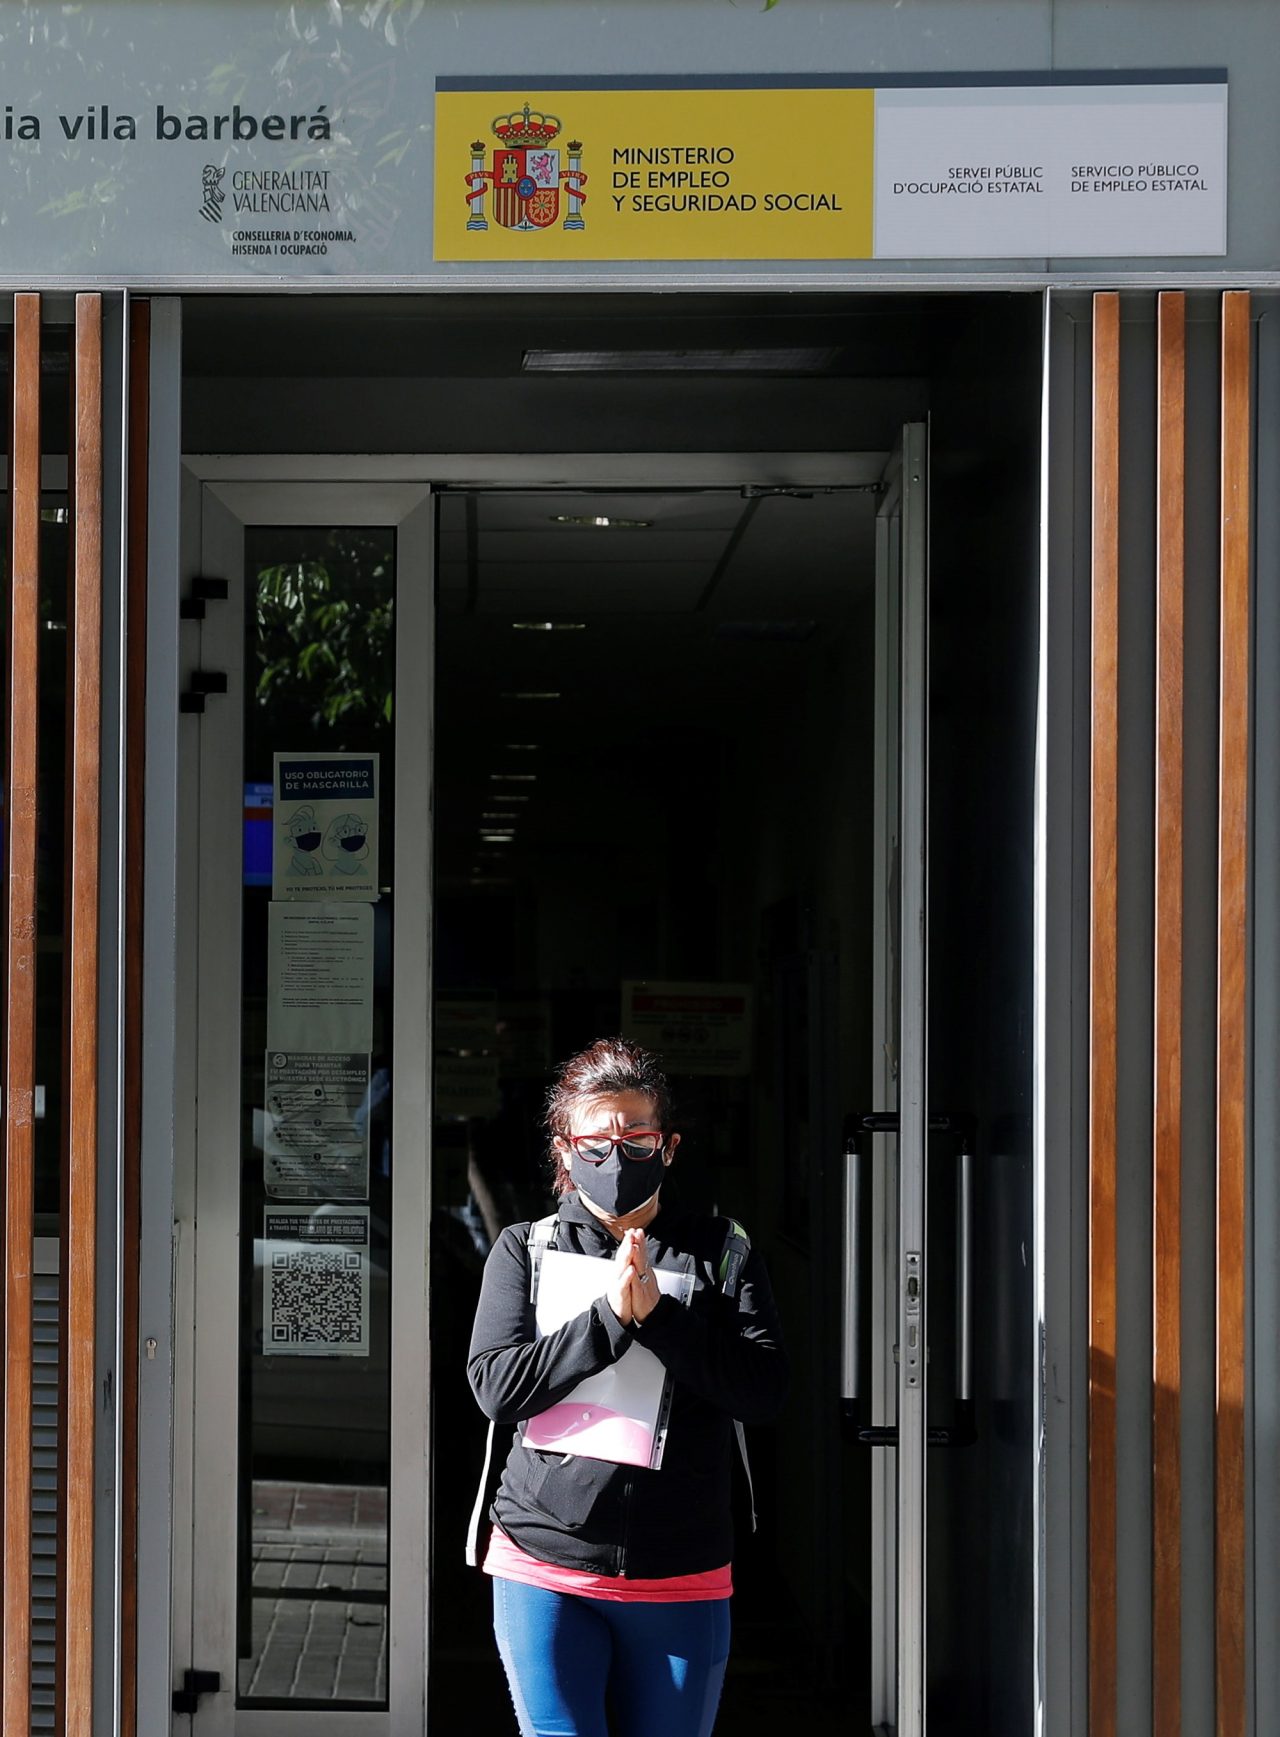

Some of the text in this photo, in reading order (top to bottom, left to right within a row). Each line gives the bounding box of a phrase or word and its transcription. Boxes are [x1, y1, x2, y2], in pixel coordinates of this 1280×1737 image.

[58, 104, 137, 141] vila
[156, 104, 332, 141] barberá
[613, 147, 735, 165] MINISTERIO
[948, 164, 1044, 179] SERVEI PÚBLIC
[1071, 162, 1199, 178] SERVICIO PÚBLICO
[232, 170, 331, 191] GENERALITAT
[612, 170, 730, 189] DE EMPLEO
[1071, 179, 1208, 193] DE EMPLEO ESTATAL
[893, 180, 1044, 195] D'OCUPACIÓ ESTATAL
[232, 192, 331, 213] VALENCIANA
[611, 193, 843, 212] Y SEGURIDAD SOCIAL
[232, 231, 357, 243] CONSELLERIA D'ECONOMIA,
[232, 245, 272, 255] HISENDA
[280, 242, 328, 255] OCUPACIÓ
[284, 770, 369, 780] USO OBLIGATORIO
[285, 780, 369, 790] DE MASCARILLA
